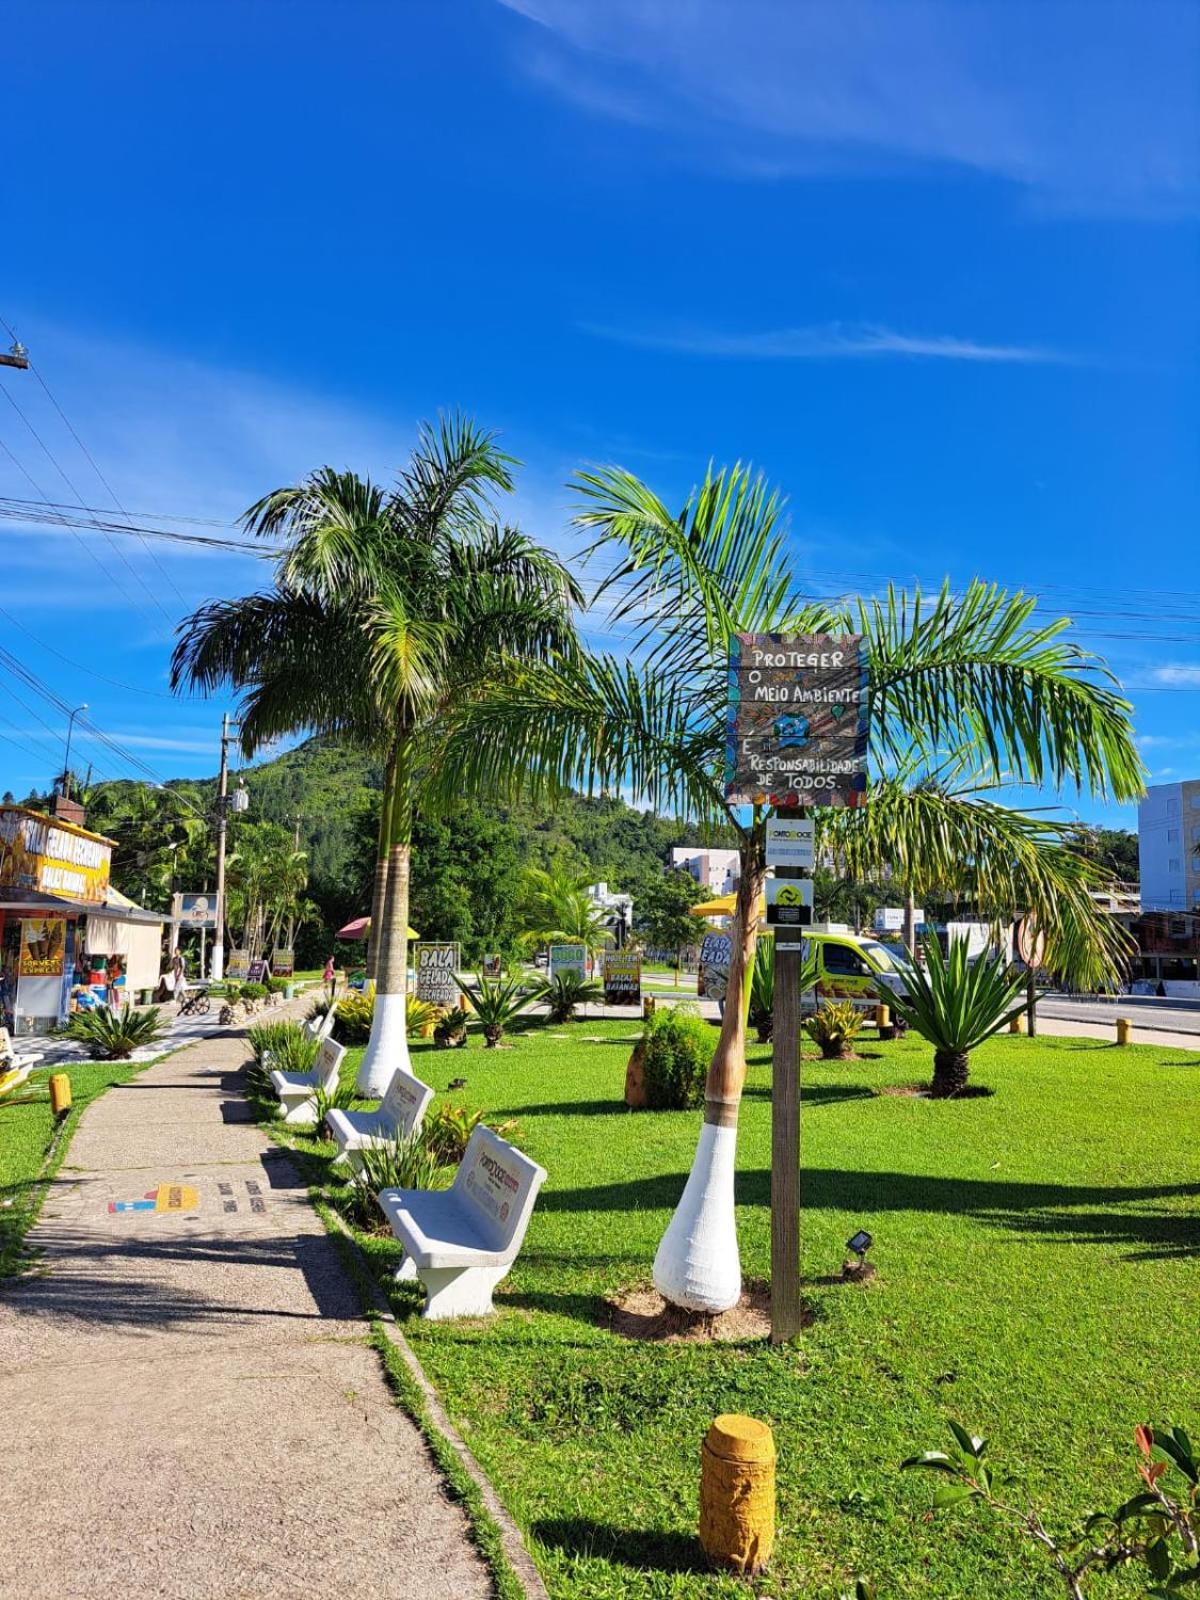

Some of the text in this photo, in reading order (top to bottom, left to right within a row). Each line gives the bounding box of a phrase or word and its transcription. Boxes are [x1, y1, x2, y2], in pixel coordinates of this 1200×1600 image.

[753, 650, 843, 668] PROTEGER
[748, 670, 762, 684] O
[754, 684, 860, 703] MEIO AMBIENTE
[749, 756, 859, 773] RESPONSABILIDADE
[756, 773, 773, 786] DE
[421, 950, 453, 967] BALA
